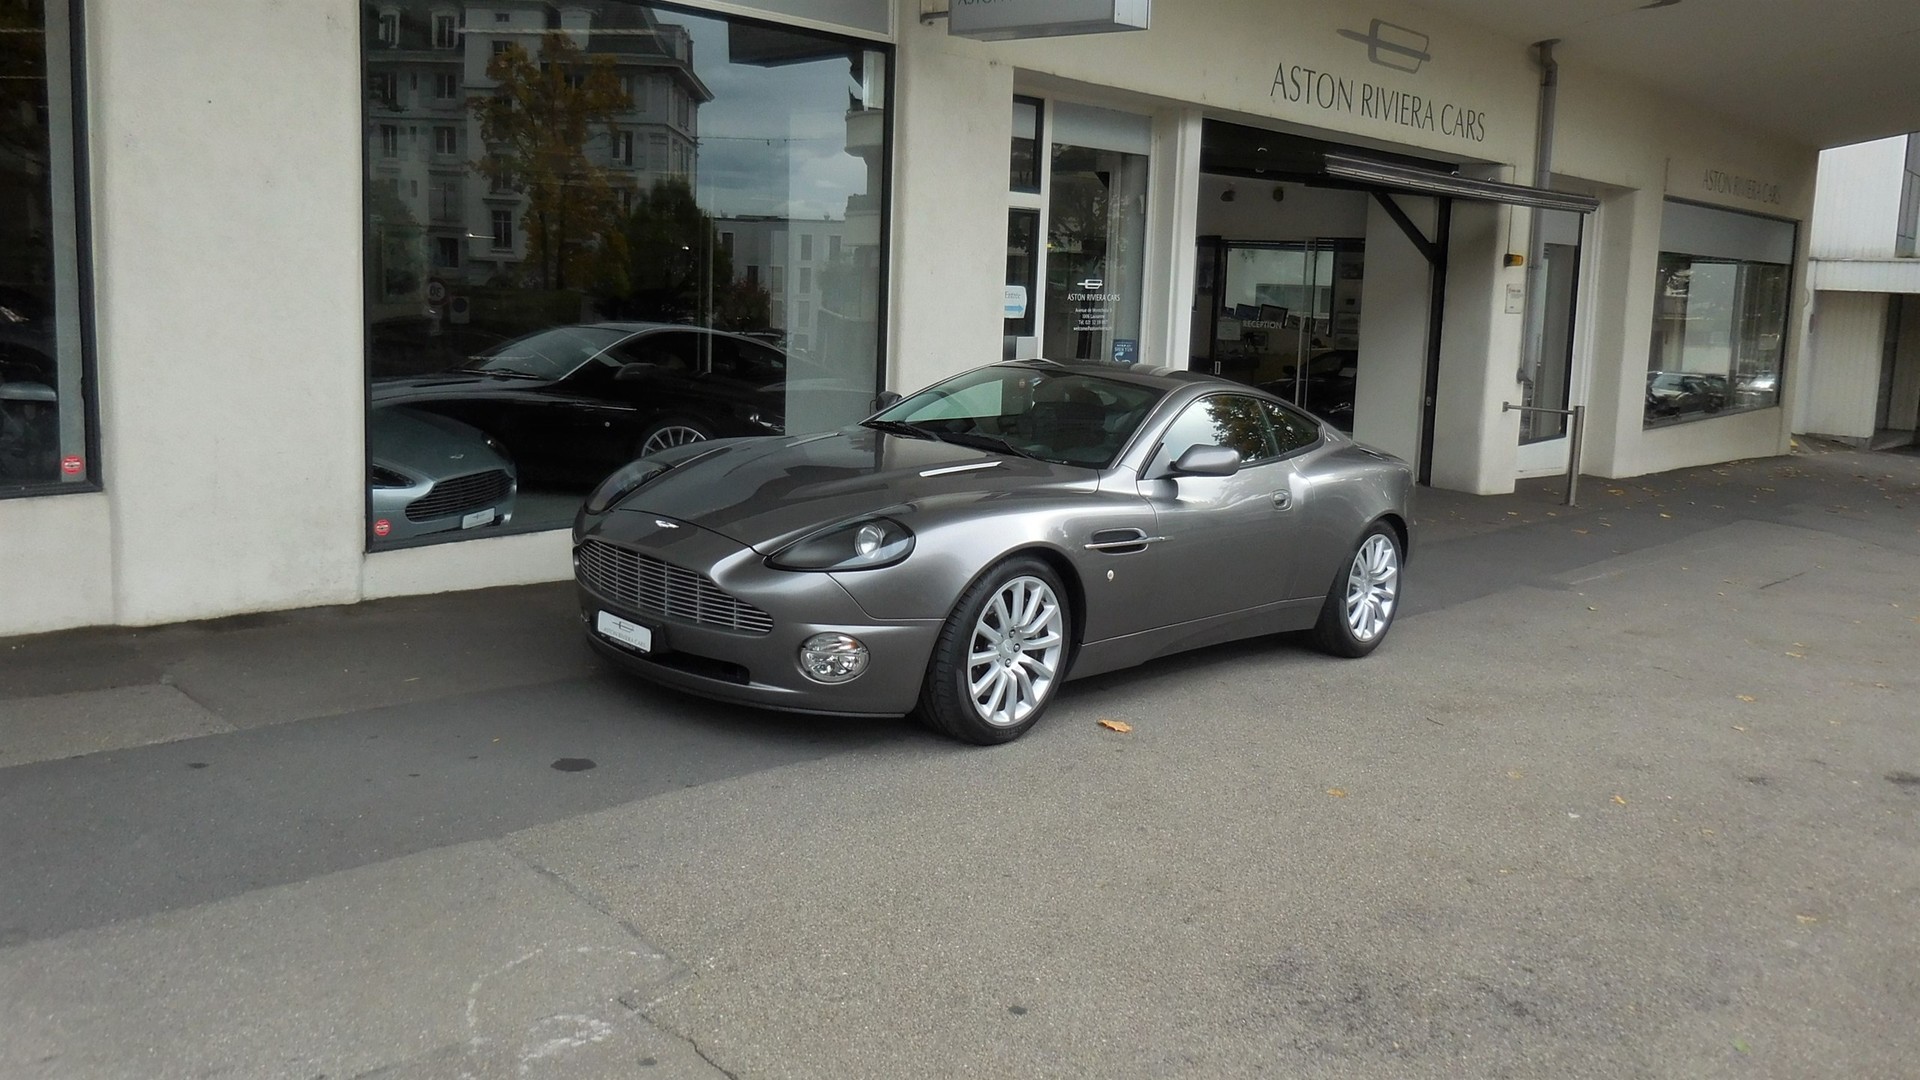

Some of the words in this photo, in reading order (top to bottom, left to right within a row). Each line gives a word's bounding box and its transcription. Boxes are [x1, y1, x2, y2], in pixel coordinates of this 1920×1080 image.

[1270, 62, 1354, 113] ASTON
[1361, 83, 1434, 132] RIVIERA
[1441, 103, 1485, 142] CARS
[1703, 168, 1731, 194] ASTON
[1067, 293, 1086, 301] ASTON
[1087, 293, 1106, 301] RIVIERA
[1107, 293, 1121, 301] CARS
[1242, 320, 1283, 329] RECEPTION
